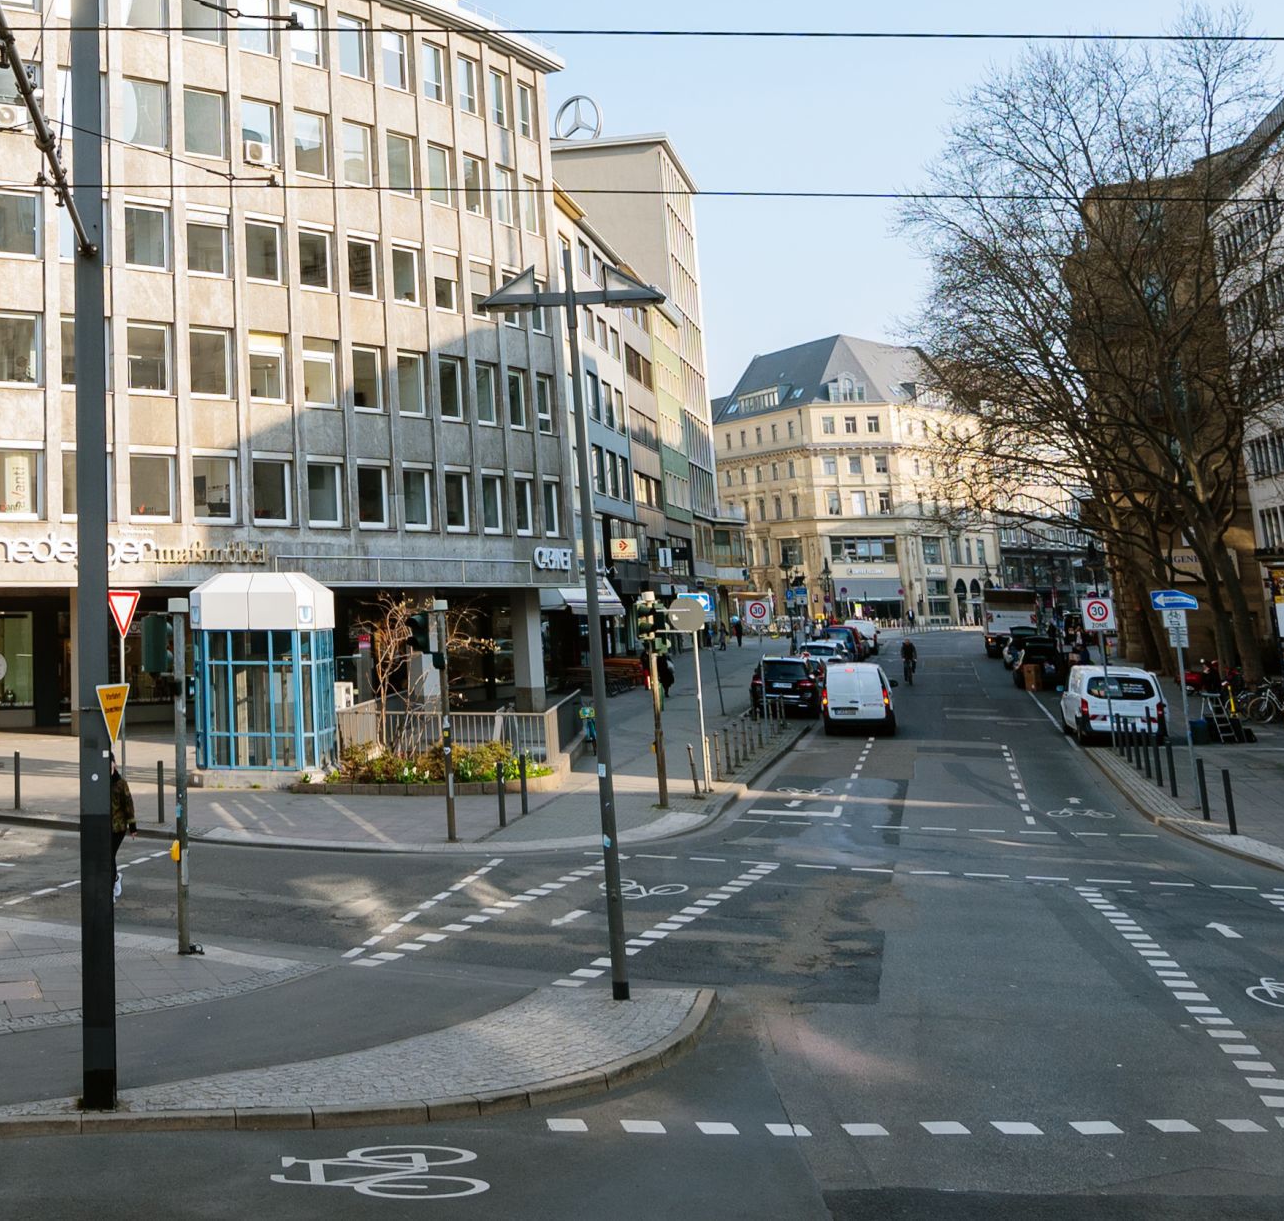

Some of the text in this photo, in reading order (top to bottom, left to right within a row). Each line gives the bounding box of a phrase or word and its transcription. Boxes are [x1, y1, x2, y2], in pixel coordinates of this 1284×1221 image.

[300, 606, 312, 623] U
[753, 606, 763, 615] 30
[1091, 606, 1104, 616] 30
